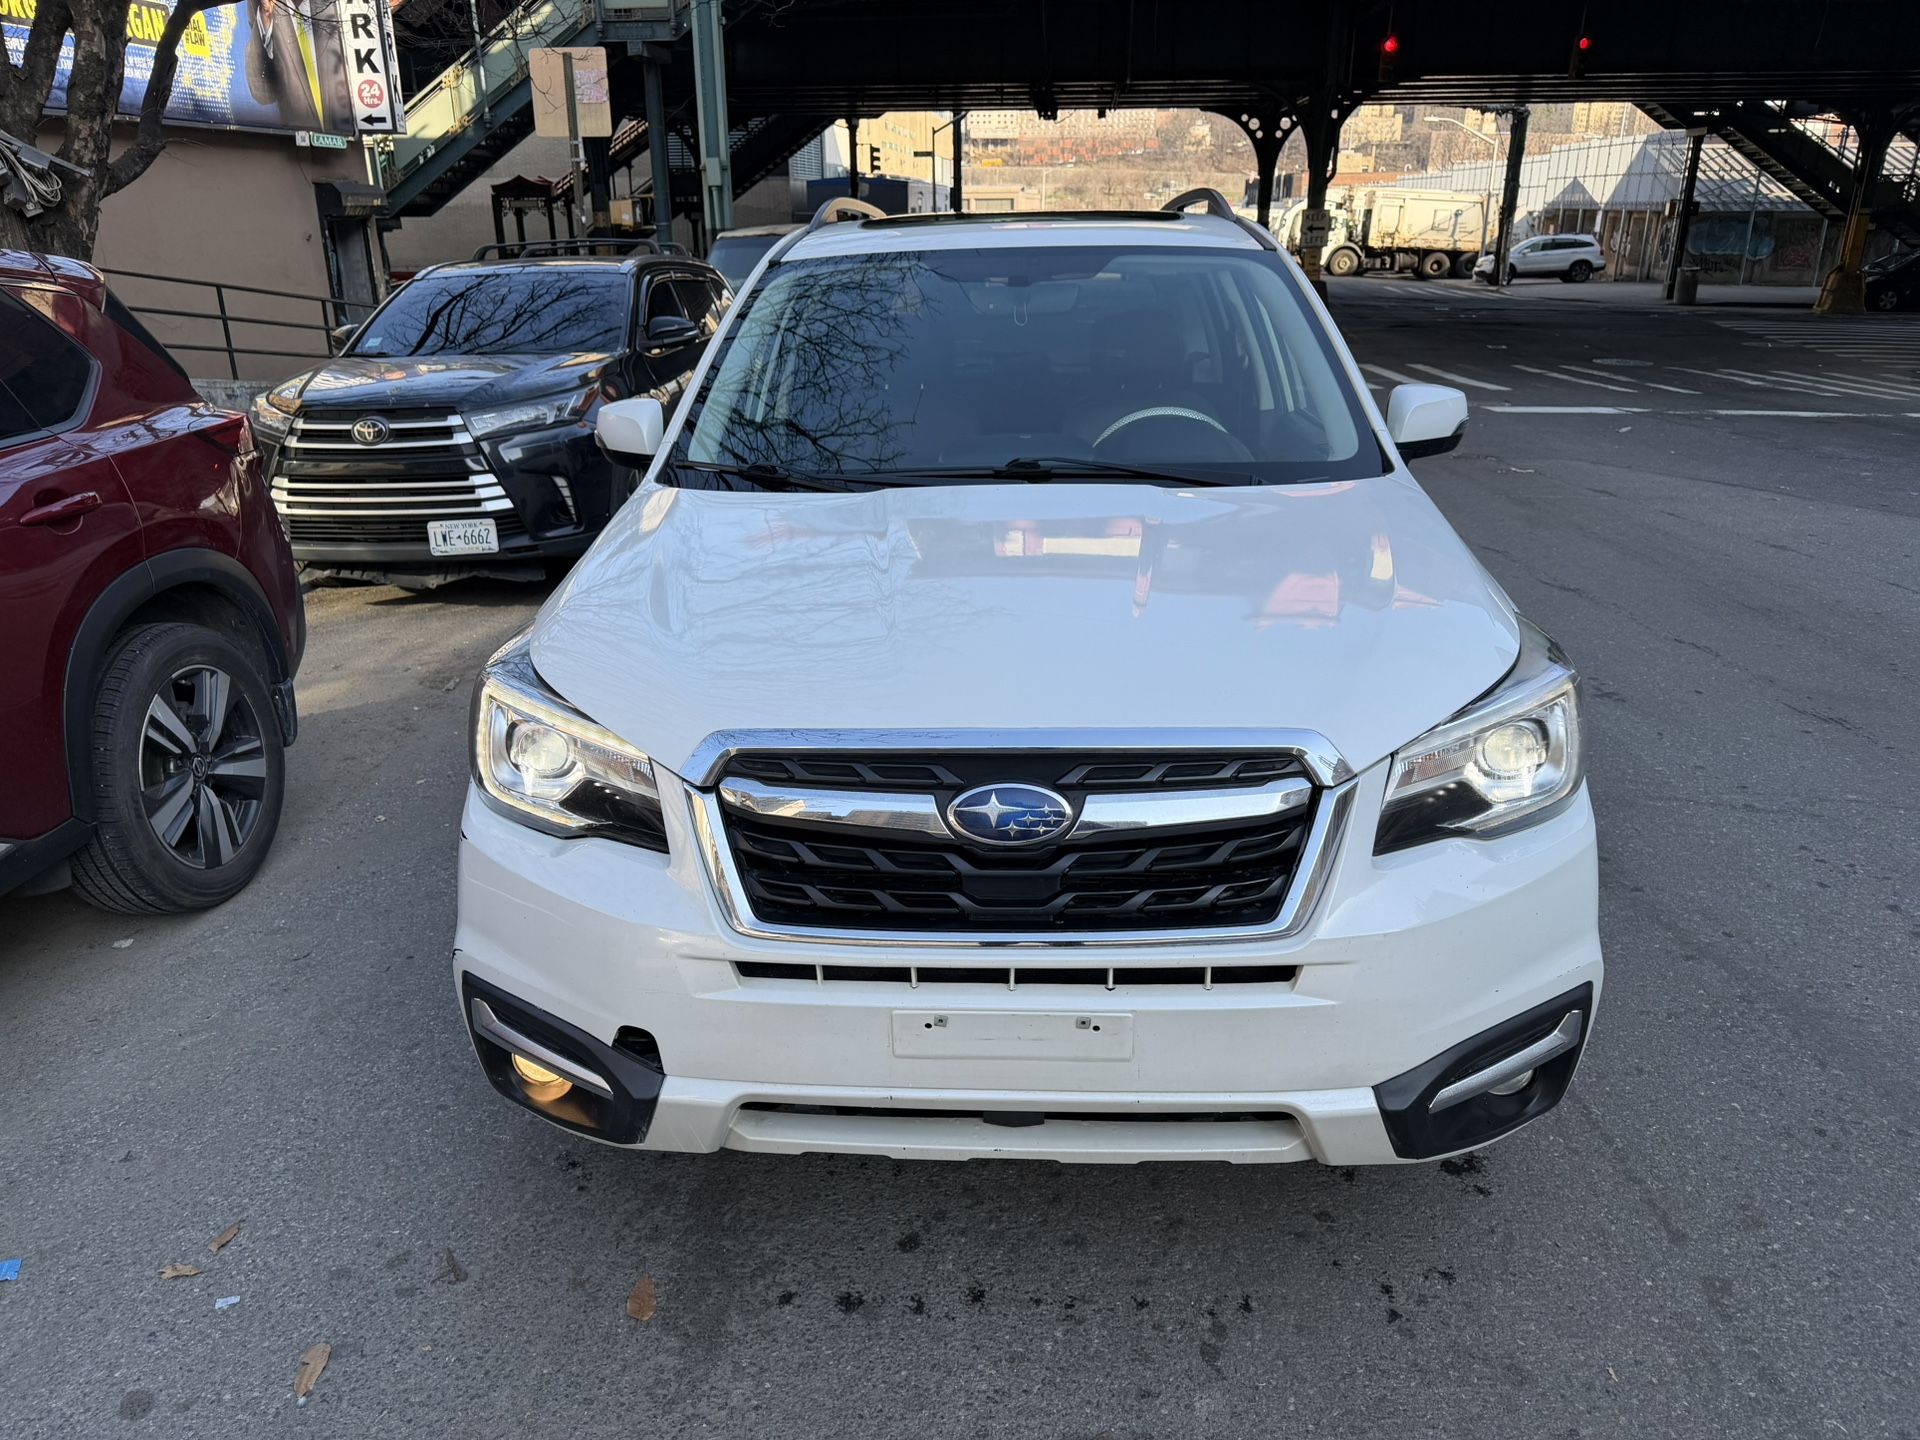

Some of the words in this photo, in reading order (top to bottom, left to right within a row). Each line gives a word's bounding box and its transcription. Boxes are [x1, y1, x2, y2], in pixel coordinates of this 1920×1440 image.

[185, 31, 206, 46] #LAW
[346, 0, 380, 73] RK
[361, 83, 380, 97] 24
[314, 135, 344, 146] LAMAR
[1305, 212, 1326, 222] KEEP
[1305, 235, 1324, 244] LEFT
